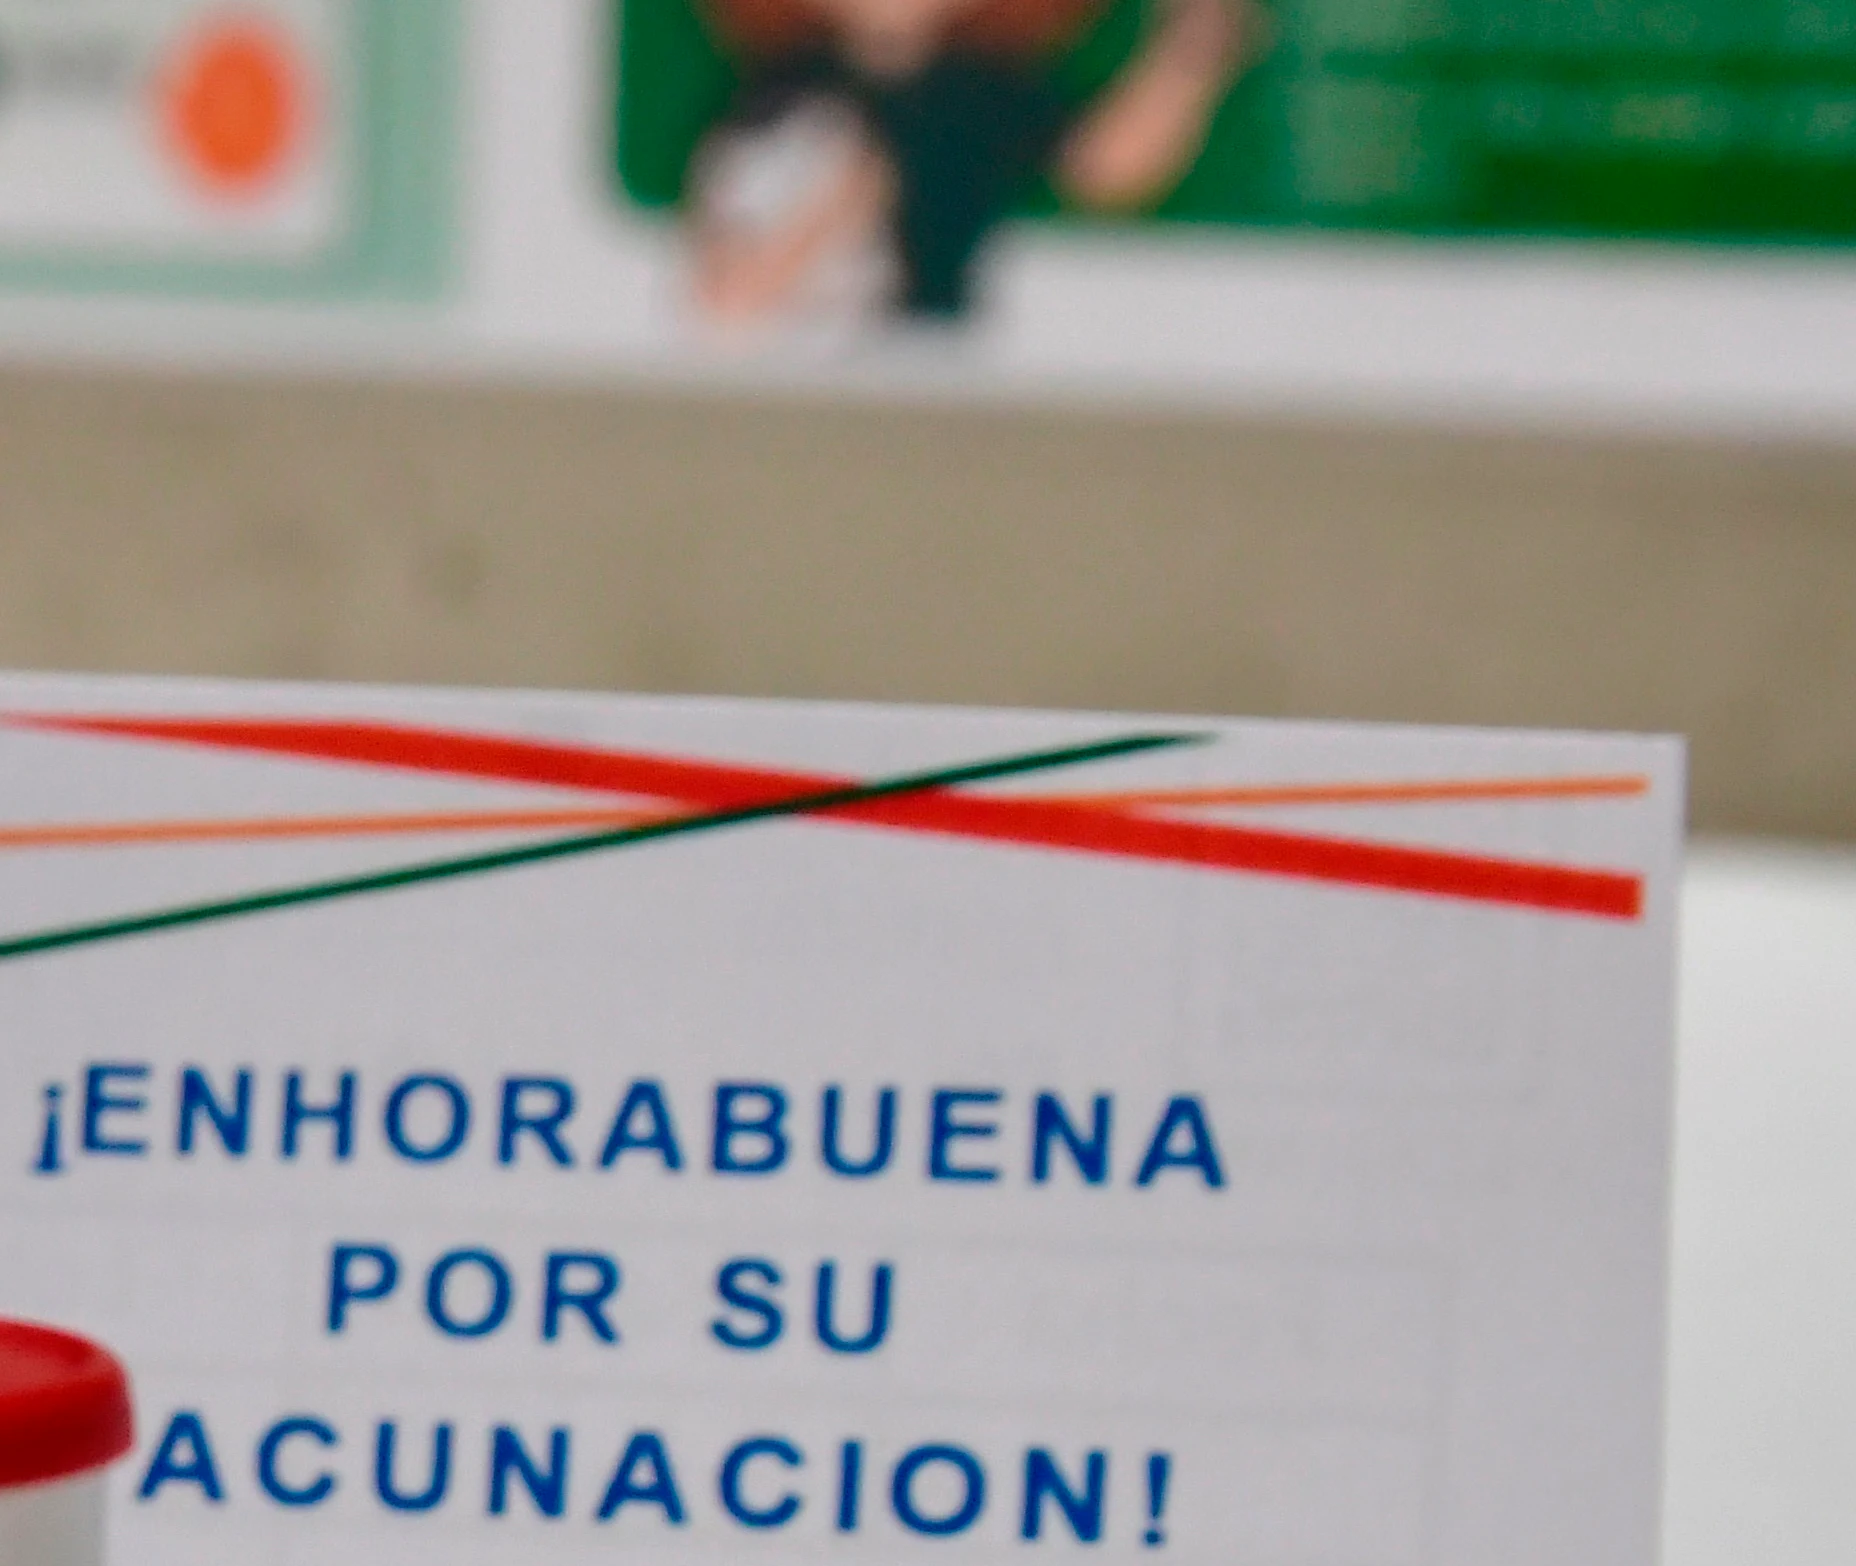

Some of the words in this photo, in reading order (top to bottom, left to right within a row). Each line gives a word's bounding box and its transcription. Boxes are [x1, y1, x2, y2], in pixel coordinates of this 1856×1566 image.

[31, 1064, 1226, 1192] ¡ENHORABUENA
[326, 1239, 623, 1345] POR
[707, 1256, 899, 1356] SU
[137, 1409, 1175, 1549] ACUNACION!
